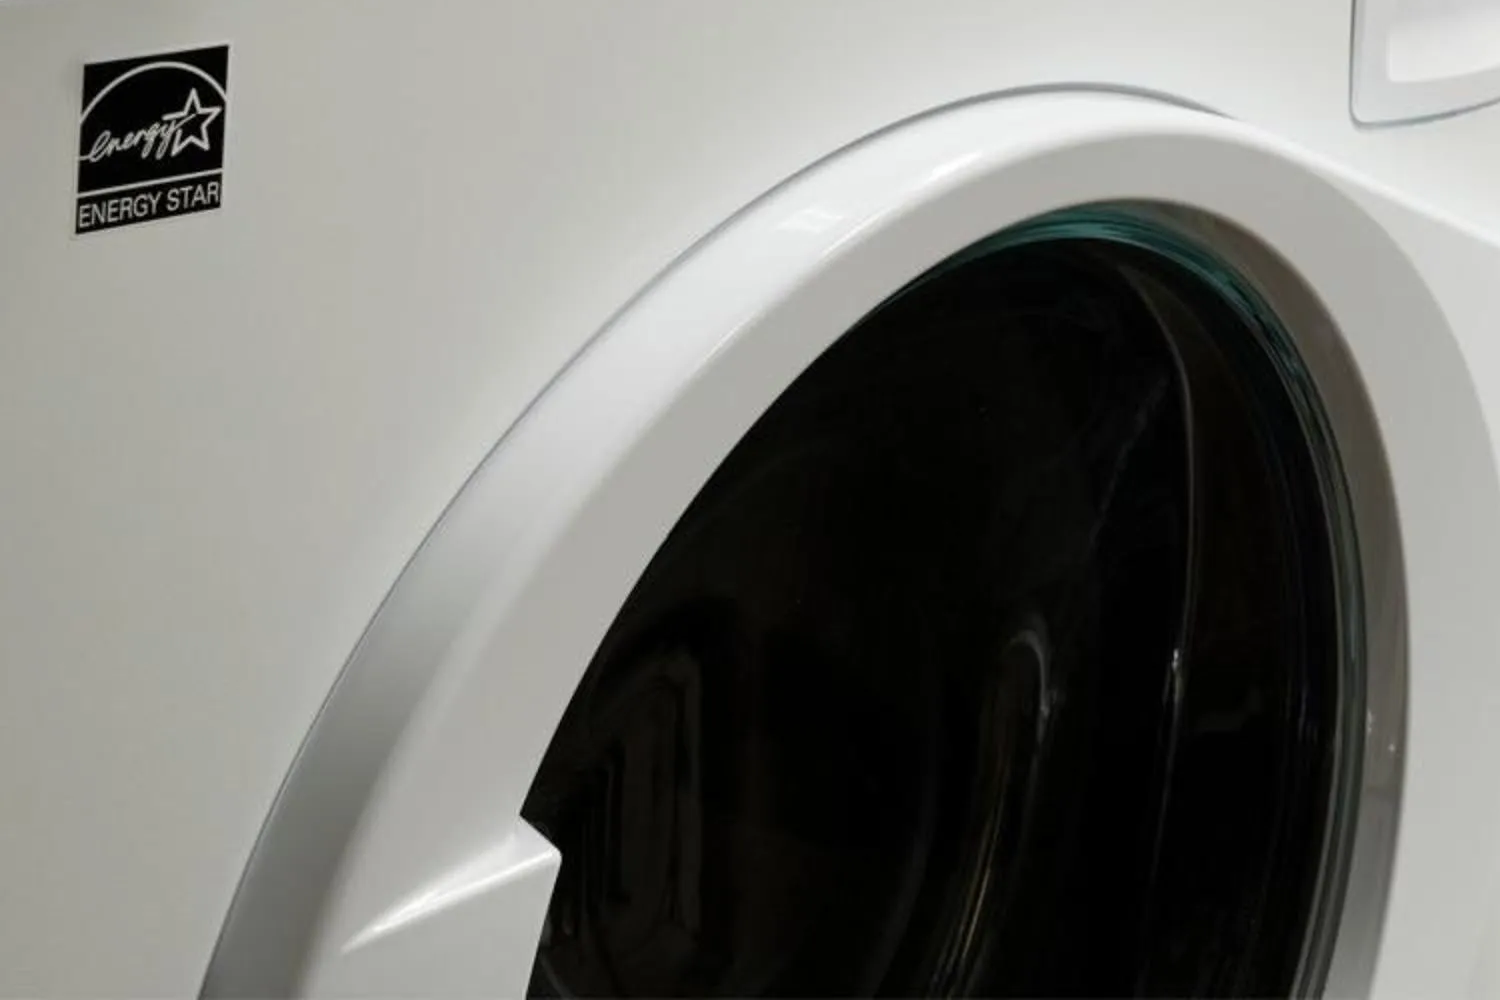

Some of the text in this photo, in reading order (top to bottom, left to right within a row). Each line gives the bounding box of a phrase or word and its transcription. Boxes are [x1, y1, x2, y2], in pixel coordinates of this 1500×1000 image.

[80, 119, 177, 163] energy
[79, 181, 220, 229] ENERGY STAR
